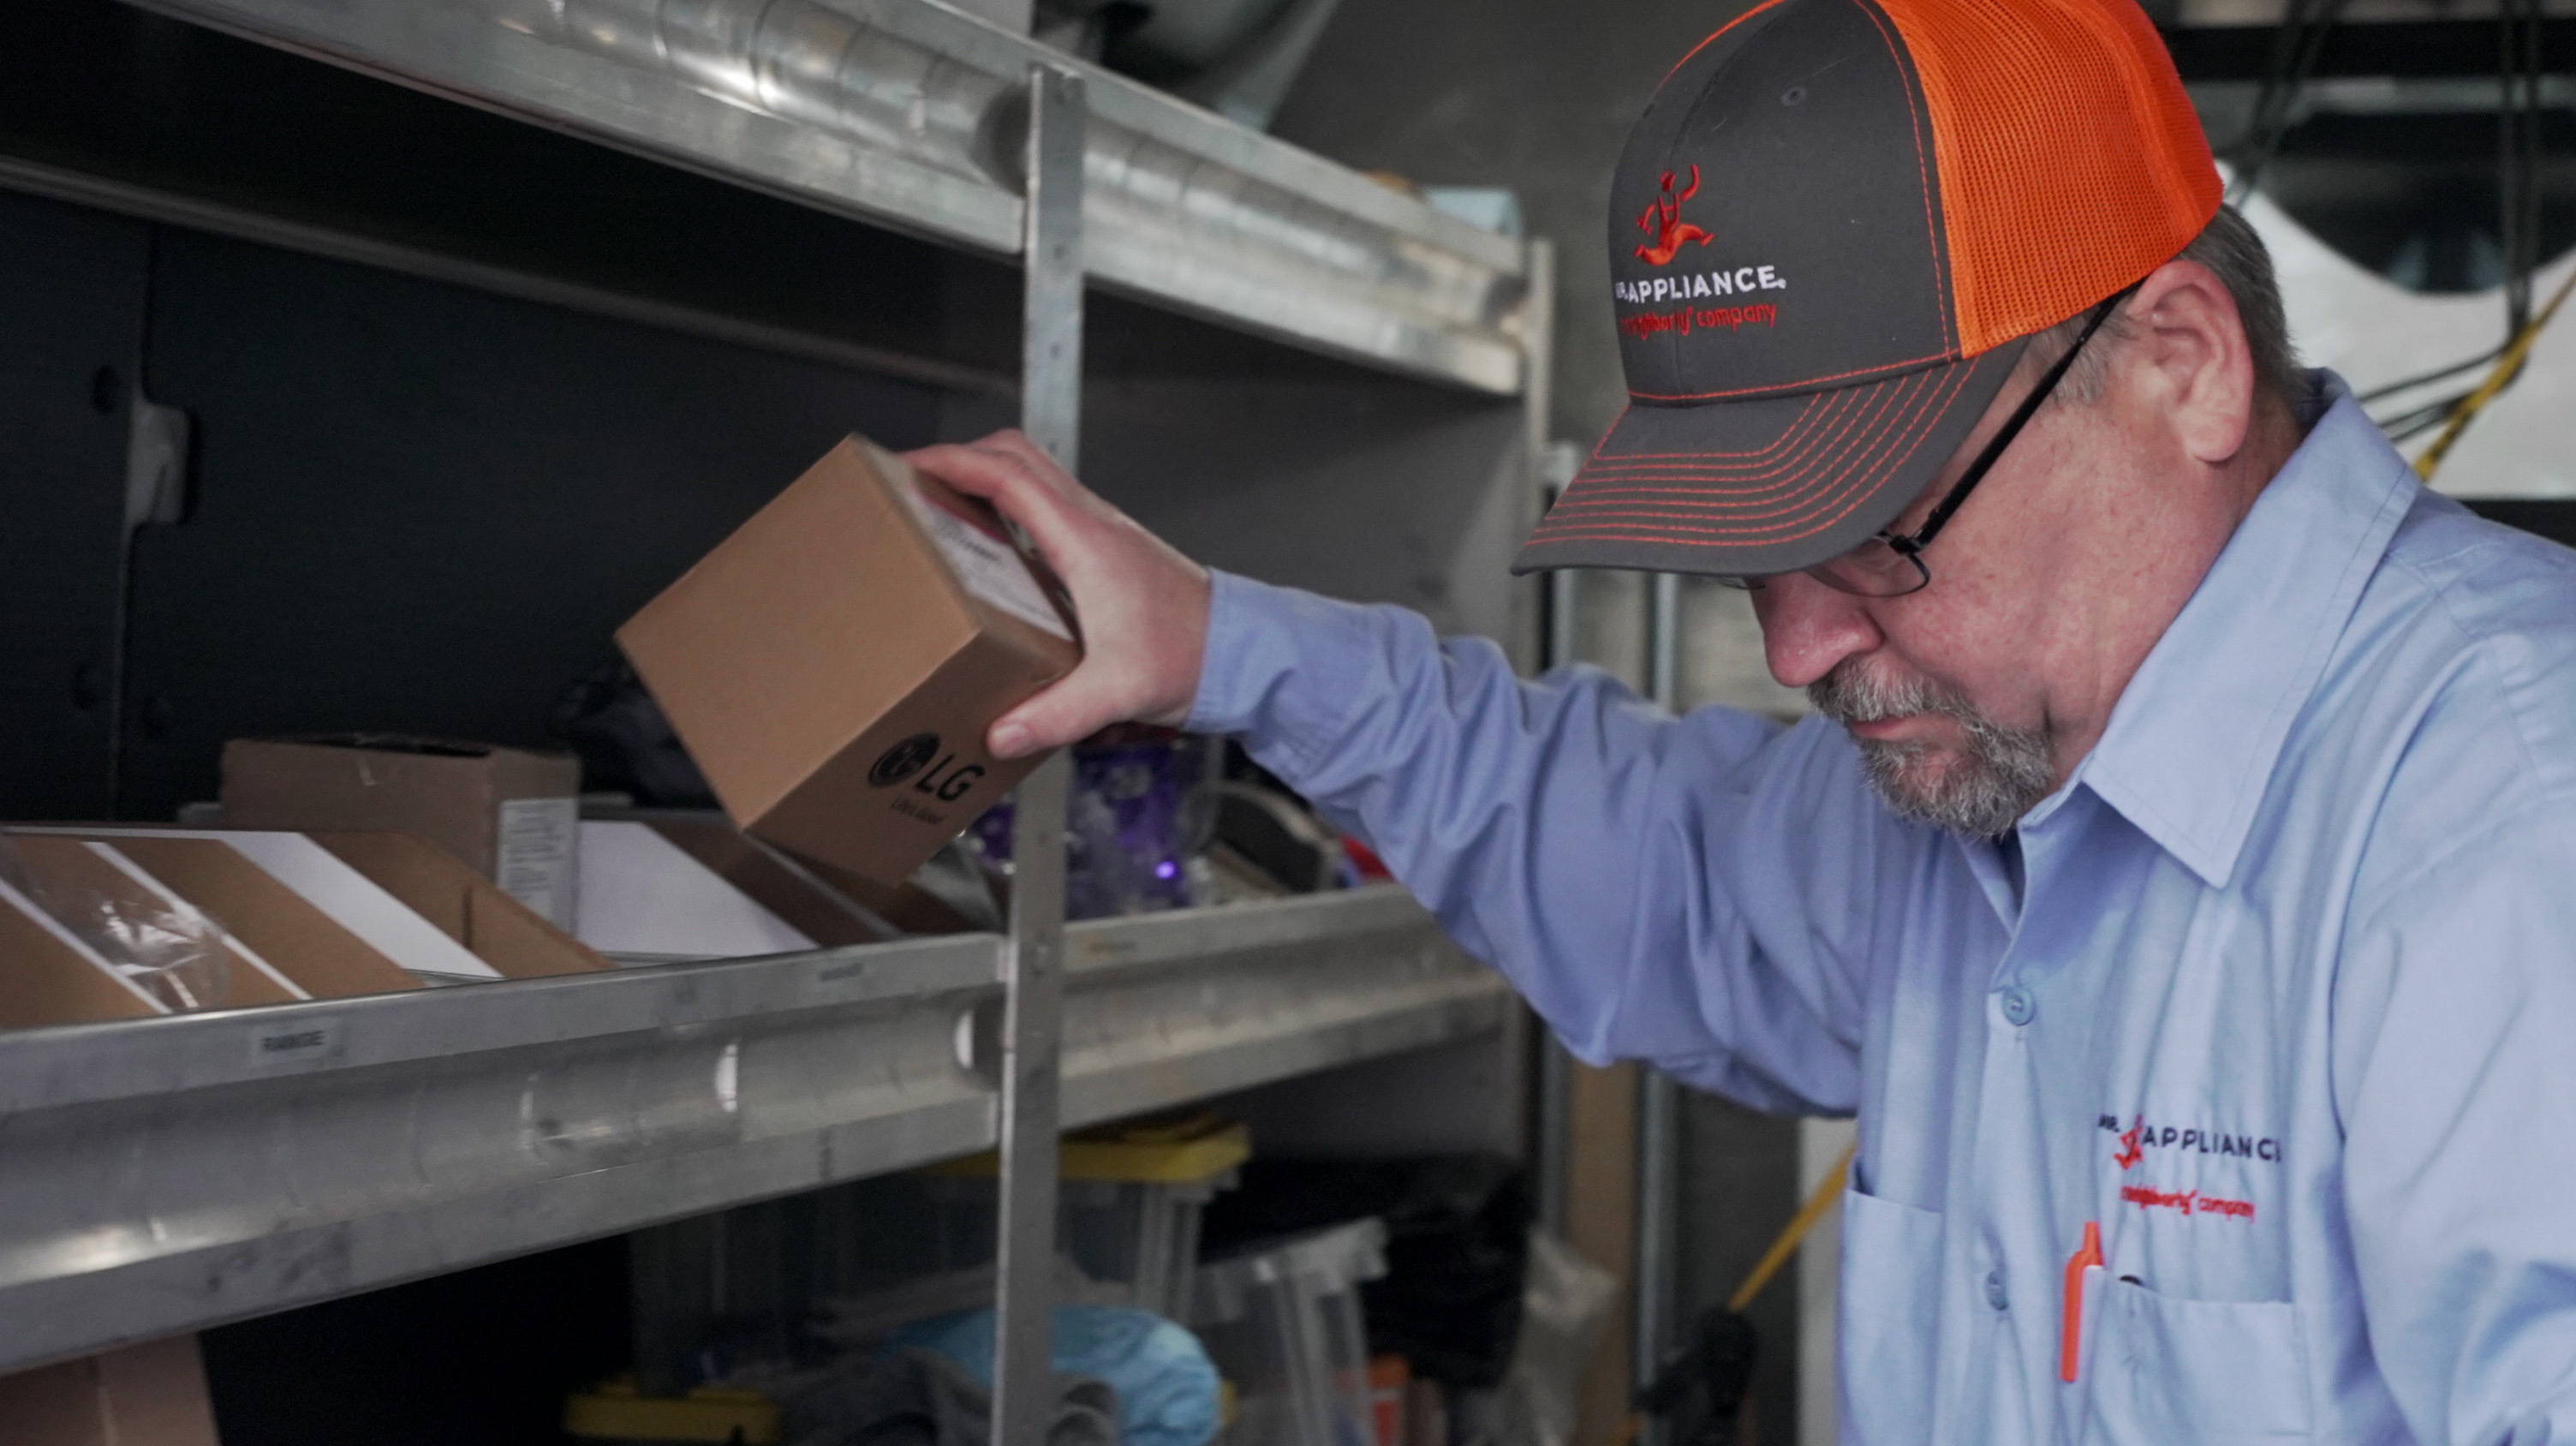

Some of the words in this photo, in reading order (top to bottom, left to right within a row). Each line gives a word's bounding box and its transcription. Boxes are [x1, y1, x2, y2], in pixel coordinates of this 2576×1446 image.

[1696, 304, 1776, 332] company
[914, 753, 985, 801] LG
[2198, 1197, 2256, 1223] company
